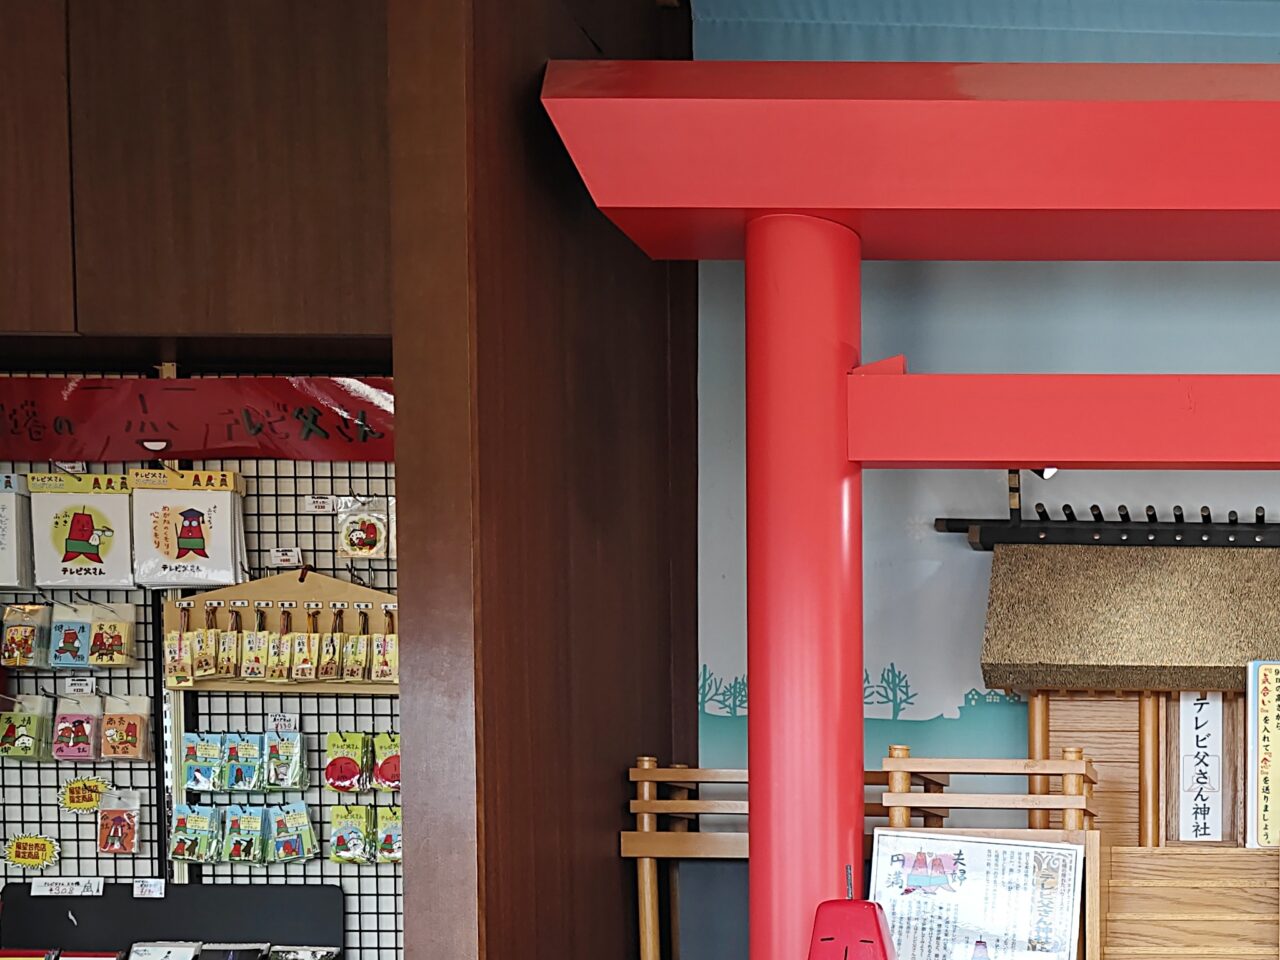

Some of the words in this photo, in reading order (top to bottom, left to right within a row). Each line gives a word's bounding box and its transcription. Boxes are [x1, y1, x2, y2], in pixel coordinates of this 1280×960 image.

[1191, 697, 1212, 838] テレビ父さん神社
